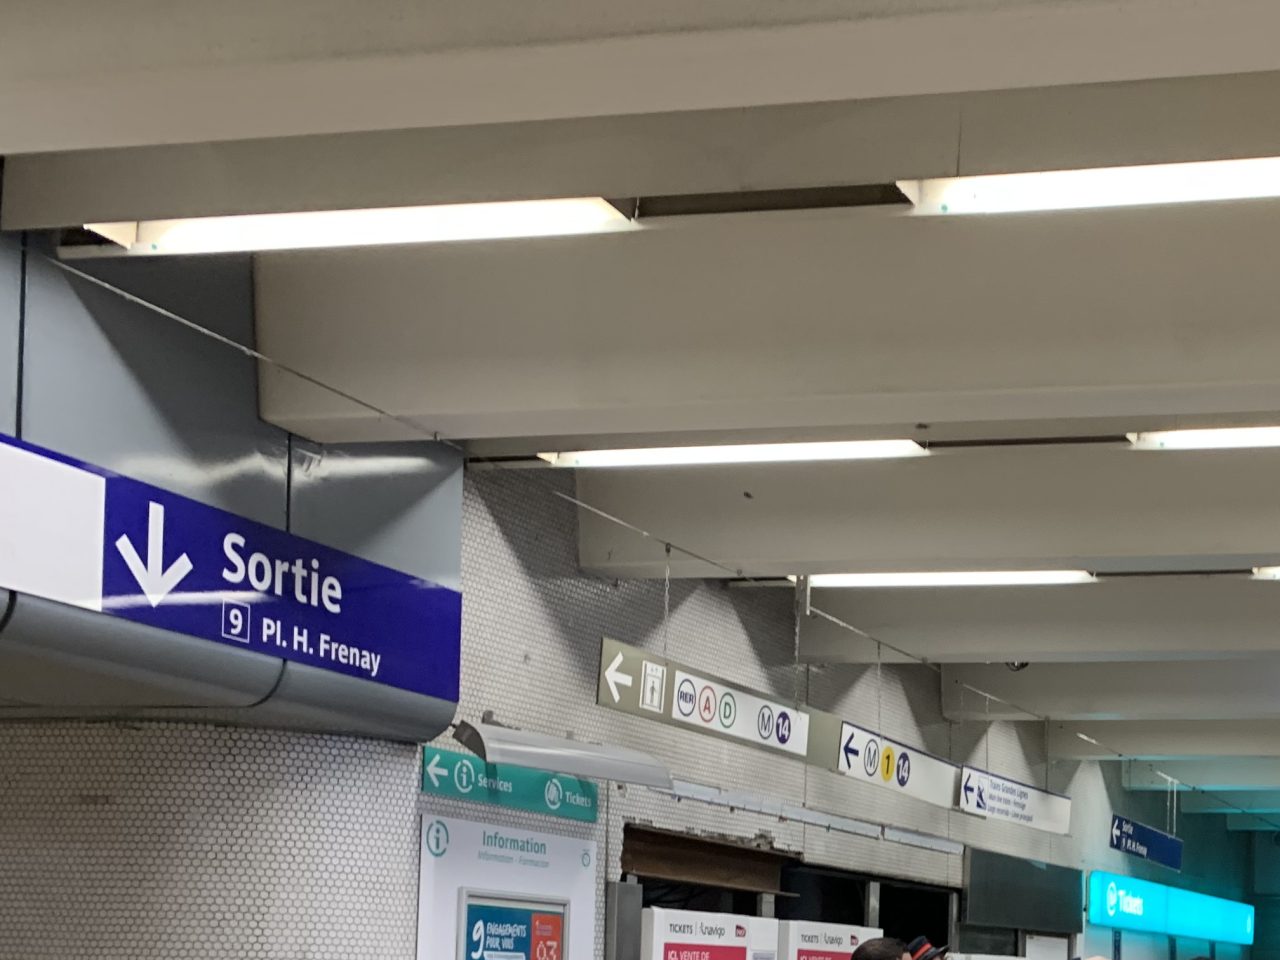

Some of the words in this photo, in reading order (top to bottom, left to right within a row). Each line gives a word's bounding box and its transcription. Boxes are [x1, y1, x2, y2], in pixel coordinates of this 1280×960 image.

[221, 531, 343, 614] Sortie
[228, 608, 244, 635] 9
[262, 617, 287, 648] Pl.
[293, 627, 314, 655] H.
[320, 634, 381, 677] Frenay
[680, 690, 694, 704] RER
[703, 696, 712, 711] A
[723, 703, 732, 719] D
[761, 711, 771, 734] M
[777, 716, 790, 740] 14
[867, 746, 877, 769] M
[898, 757, 909, 781] 14
[478, 773, 513, 793] Services
[565, 791, 592, 808] Tickets
[482, 830, 547, 855] Information
[1117, 889, 1144, 917] Tickets
[471, 919, 485, 960] 9
[485, 935, 500, 951] POUR
[501, 937, 514, 950] VOUS
[486, 921, 527, 938] ENGAGEMENTS
[669, 923, 693, 934] TICKETS
